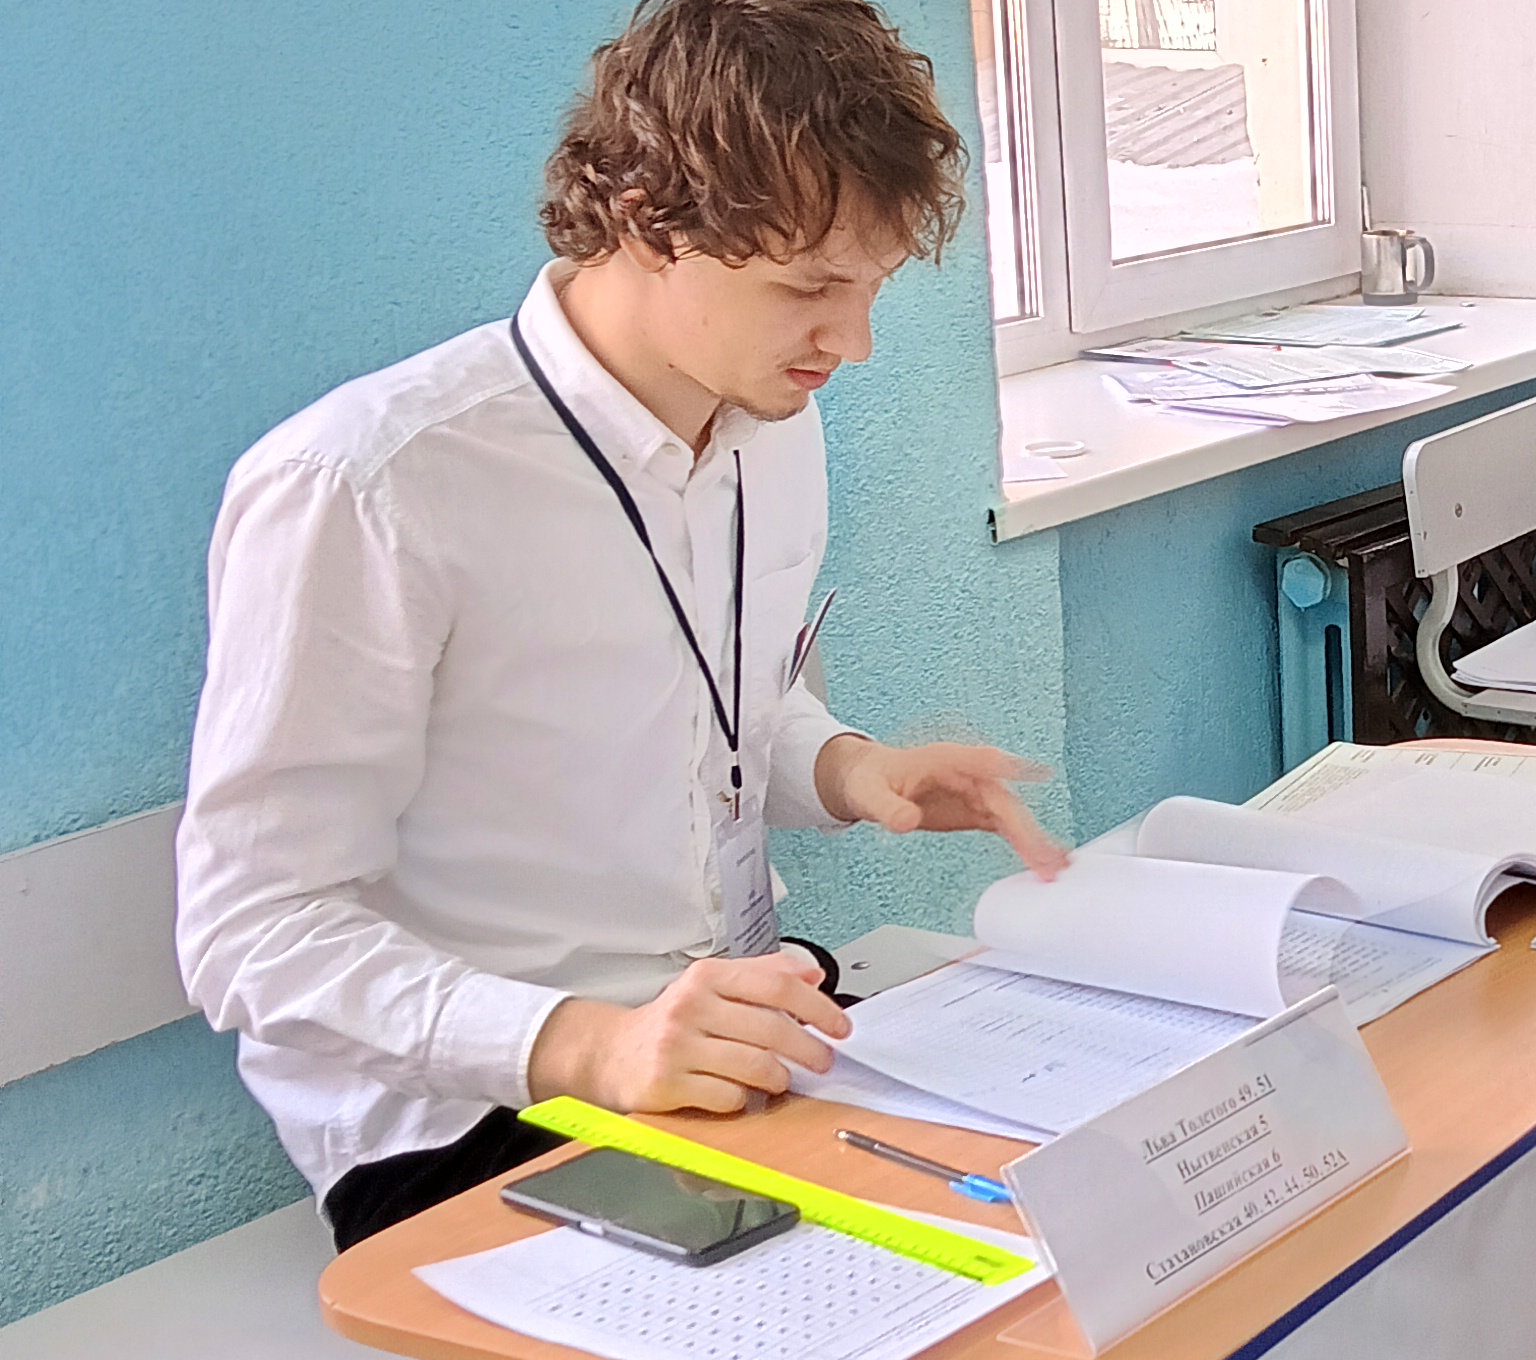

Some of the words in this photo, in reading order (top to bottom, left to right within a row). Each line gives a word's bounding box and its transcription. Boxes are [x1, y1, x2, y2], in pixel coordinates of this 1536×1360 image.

[1141, 1132, 1177, 1160] Льва
[1177, 1097, 1237, 1137] Толстого
[1256, 1073, 1273, 1093] 51
[1177, 1124, 1259, 1179] Нытвенская
[1194, 1158, 1270, 1211] Пашийская
[1146, 1216, 1242, 1280] Стахановская
